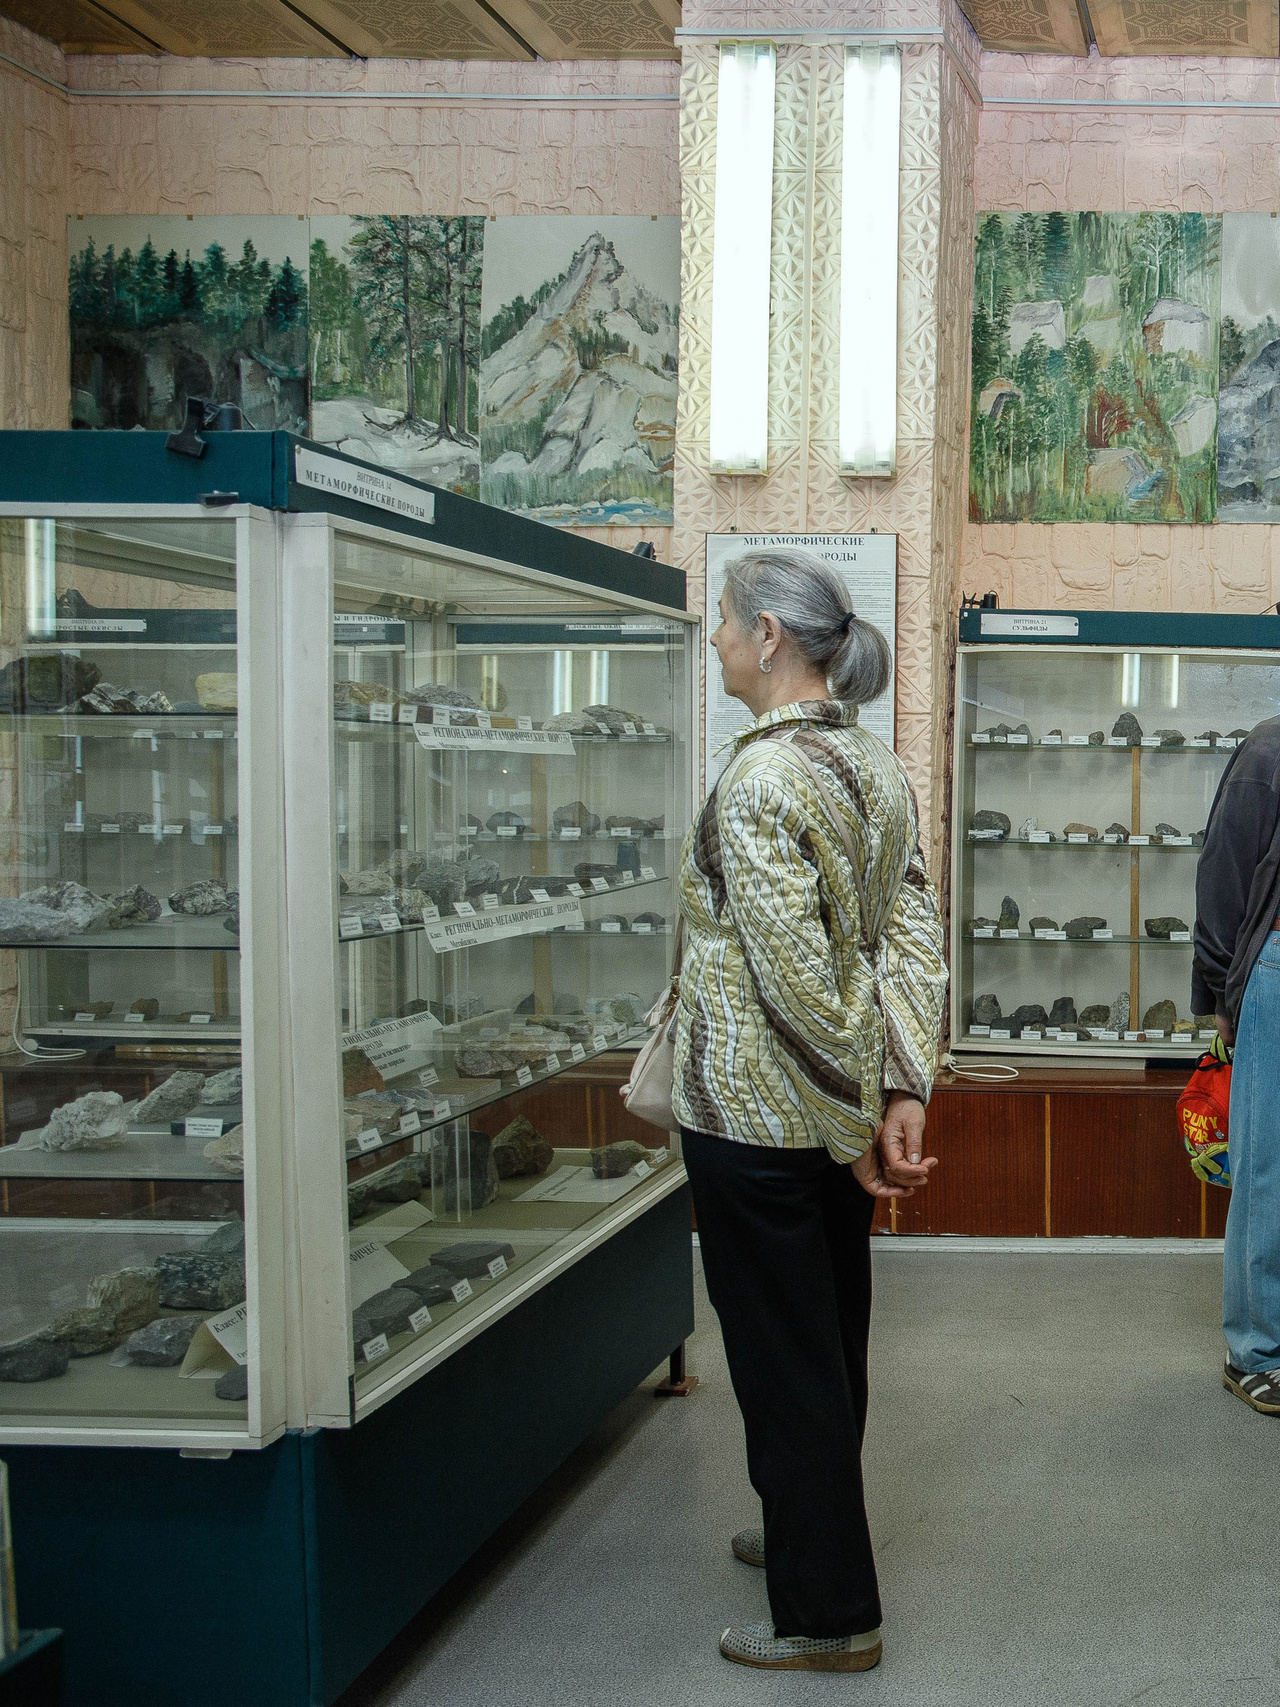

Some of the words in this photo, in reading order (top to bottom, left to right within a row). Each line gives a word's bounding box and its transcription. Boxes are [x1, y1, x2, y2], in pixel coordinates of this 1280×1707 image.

[305, 469, 396, 508] МЕТАМОРФИЧЕСКИЕ
[397, 499, 425, 518] ПОРОДЫ
[743, 537, 865, 546] МЕТАМОРФИЧЕСКИЕ
[820, 552, 857, 562] РОДЫ
[432, 726, 546, 743] РЕГИОНАЛЬНО-МЕТАМОРФИЧЕСКИЕ
[444, 905, 555, 936] РЕГИОНАЛЬНО-МЕТАМОРФИЧЕСКИЕ
[556, 900, 580, 914] ПОРОДЫ
[1183, 1122, 1210, 1144] STAR
